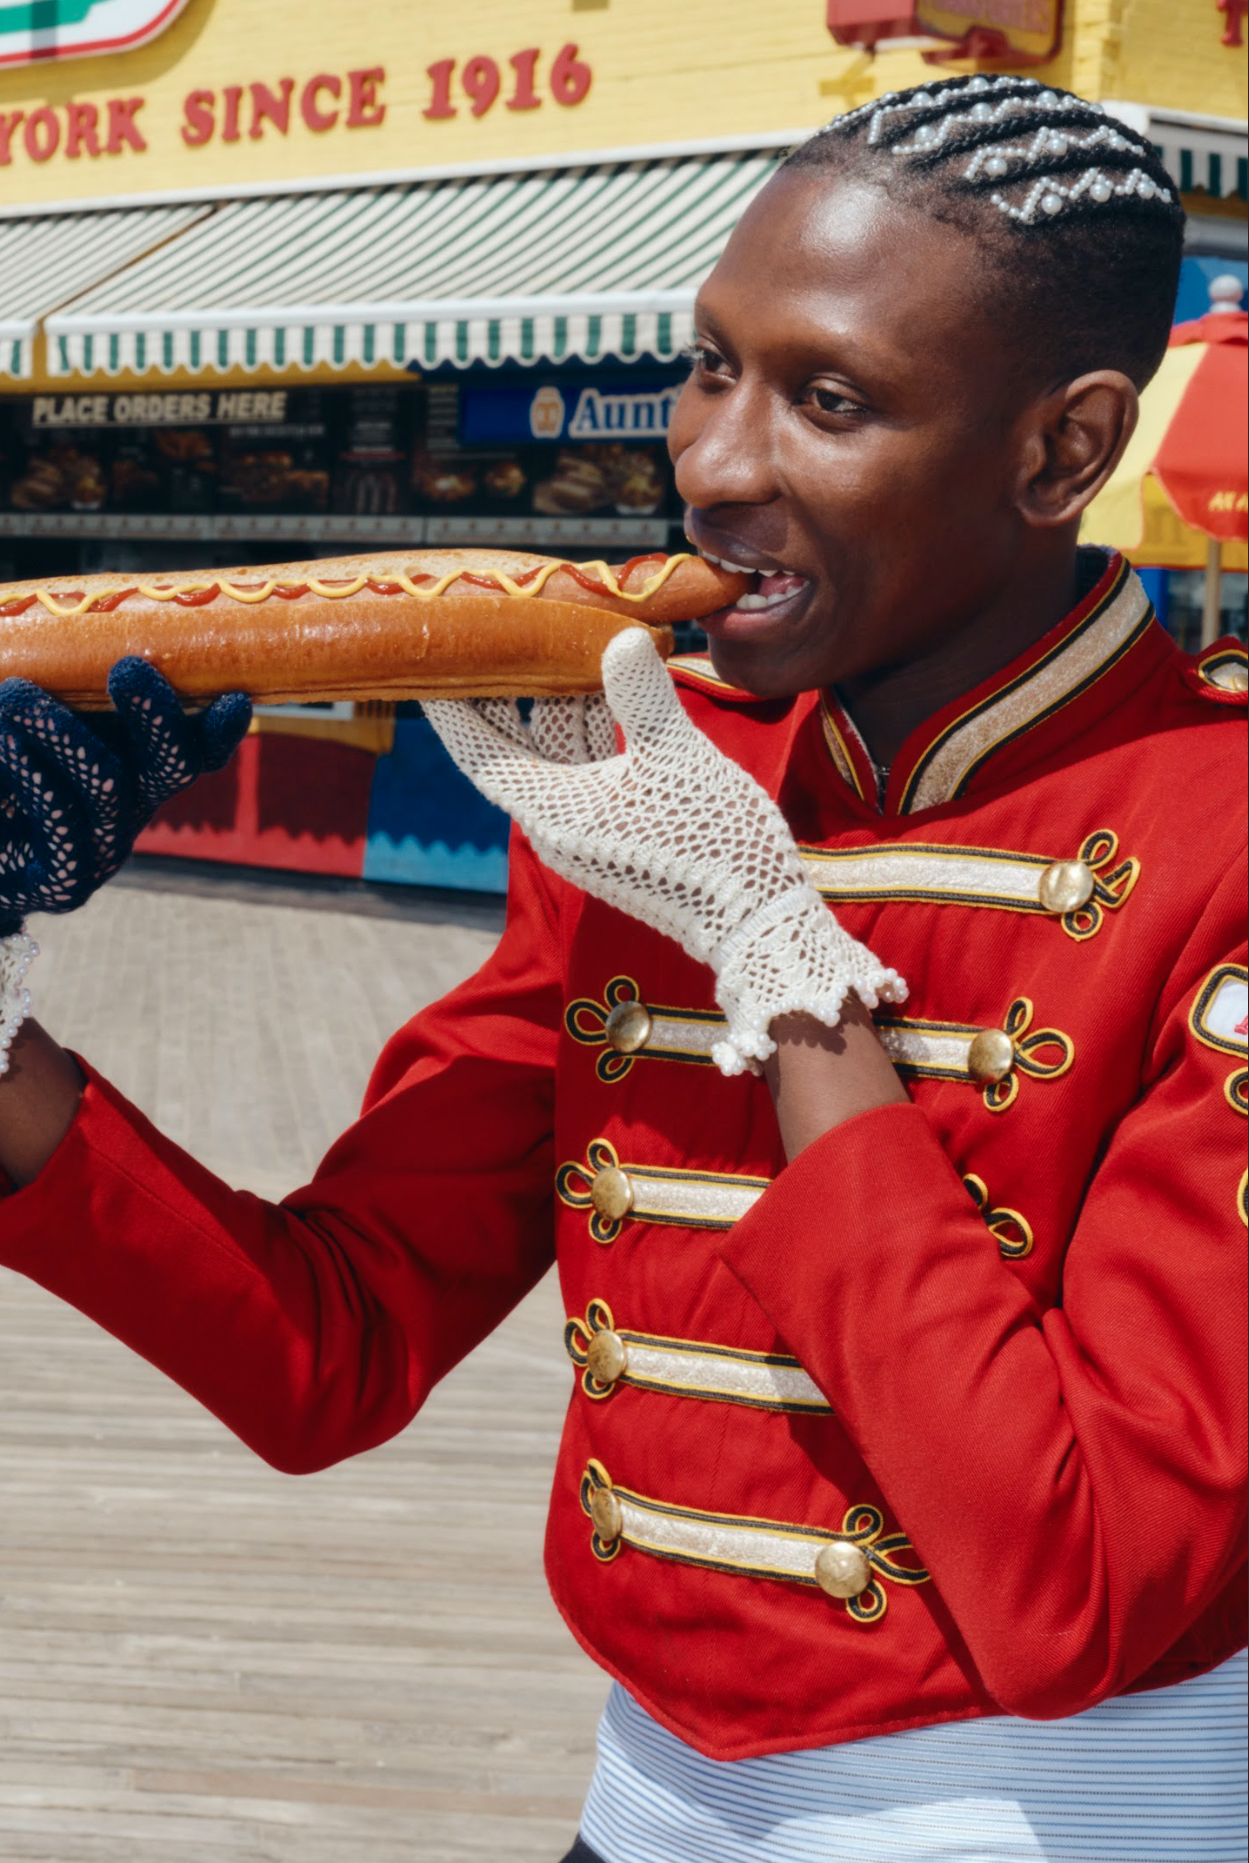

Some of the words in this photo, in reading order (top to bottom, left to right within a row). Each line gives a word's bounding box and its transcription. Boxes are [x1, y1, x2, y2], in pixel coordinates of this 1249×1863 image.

[180, 66, 387, 148] SINCE
[422, 43, 593, 119] 1916
[33, 396, 109, 424] PLACE
[113, 393, 212, 422] ORDERS
[217, 391, 288, 419] HERE
[570, 387, 681, 438] Aunt
